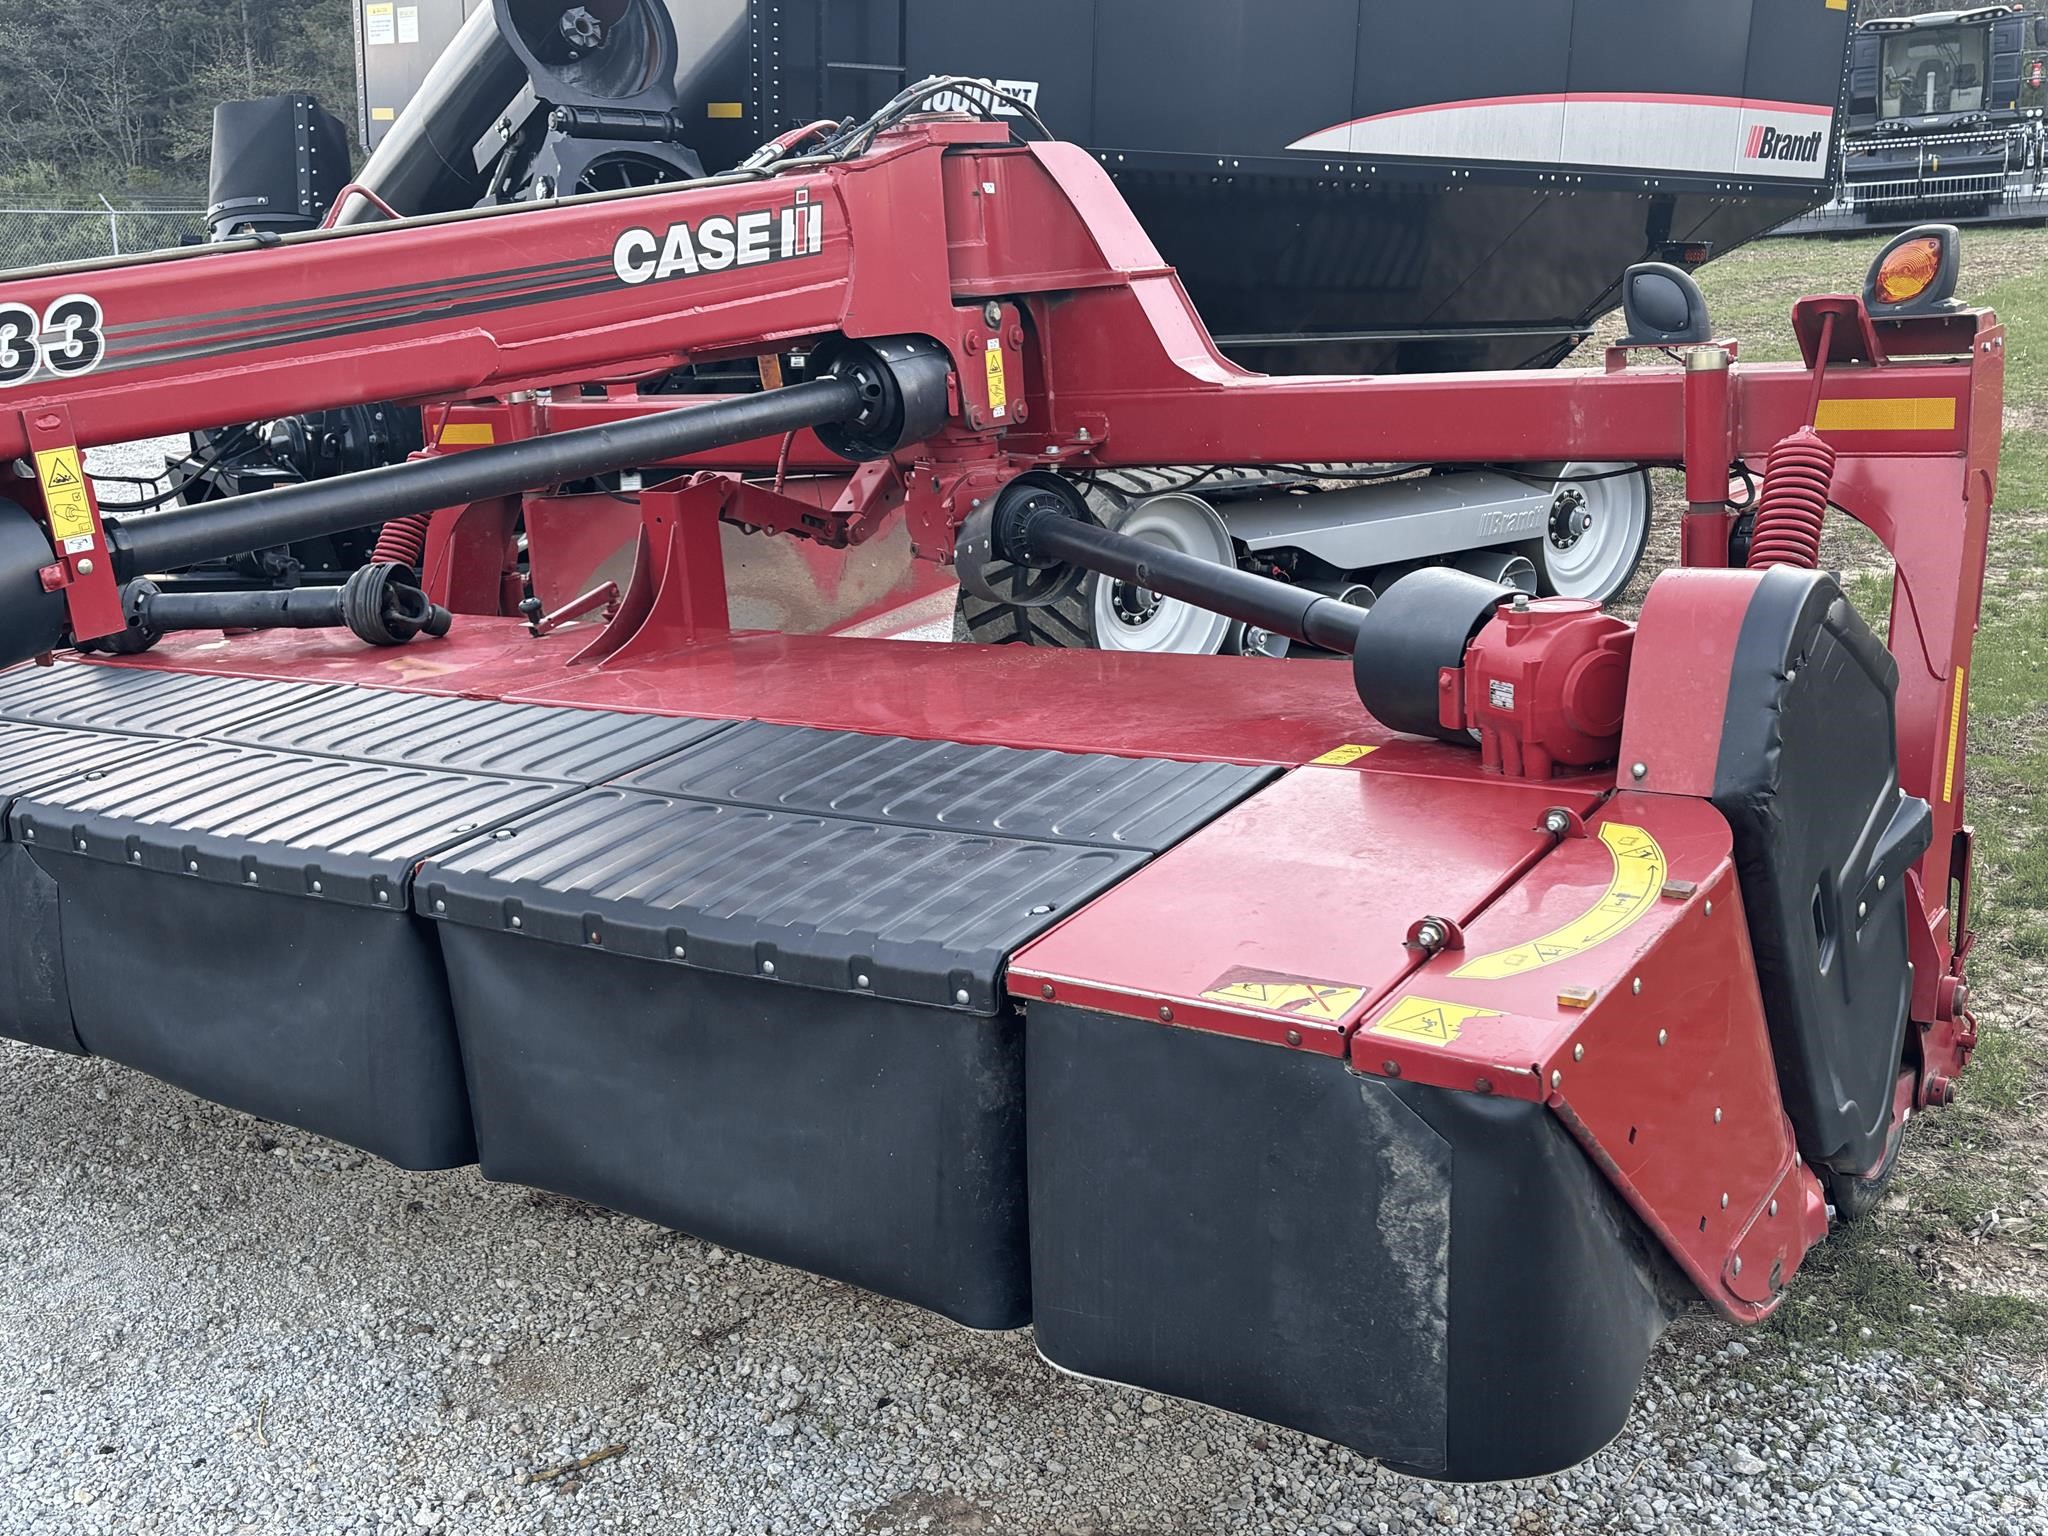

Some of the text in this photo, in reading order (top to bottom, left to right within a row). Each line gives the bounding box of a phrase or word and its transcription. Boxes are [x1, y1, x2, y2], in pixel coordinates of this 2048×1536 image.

[1757, 125, 1823, 162] Brandt
[612, 211, 771, 284] CASE
[0, 293, 105, 388] 33
[1486, 504, 1544, 536] Brandt
